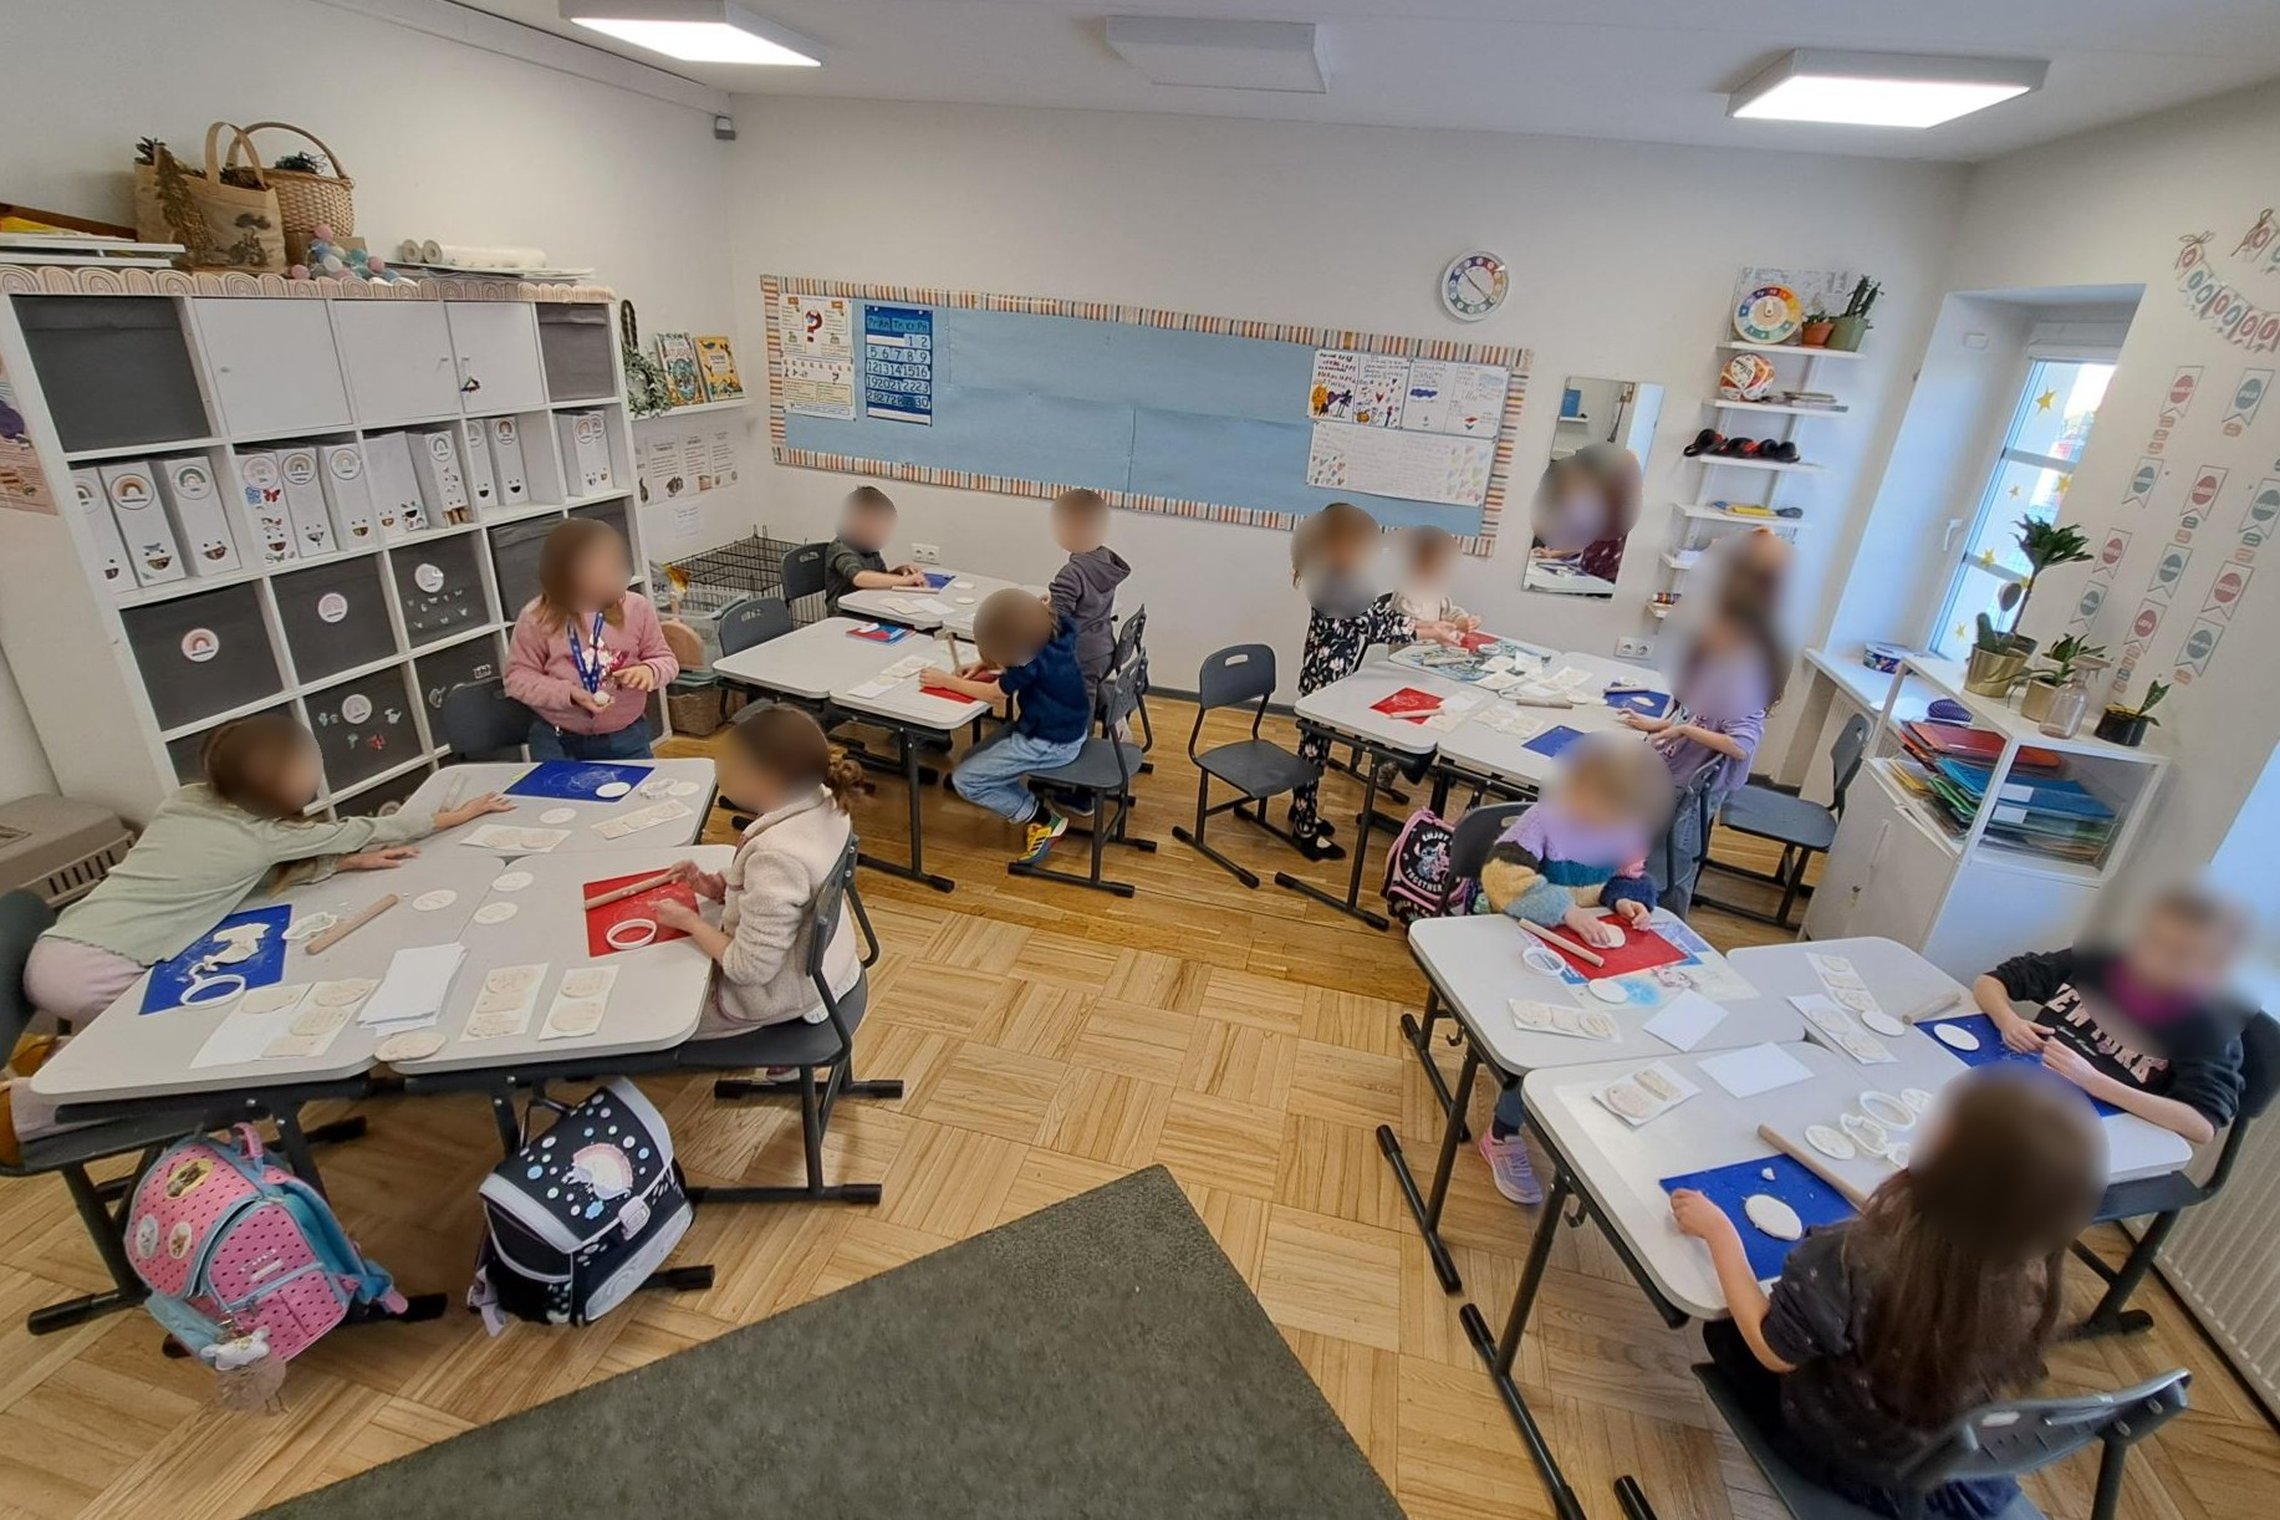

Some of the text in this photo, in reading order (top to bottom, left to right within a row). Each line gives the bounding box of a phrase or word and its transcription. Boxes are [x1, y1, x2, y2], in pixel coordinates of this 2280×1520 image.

[908, 336, 928, 347] 1 2
[871, 347, 927, 363] 5 6 7 8 9
[868, 361, 928, 378] 12 13 14 15 16
[867, 376, 877, 387] 19
[878, 378, 890, 389] 20
[903, 381, 915, 391] 22
[916, 382, 929, 393] 23
[1422, 832, 1450, 842] ENJOY
[1406, 868, 1443, 892] TOGETHER
[2045, 983, 2092, 1028] EW
